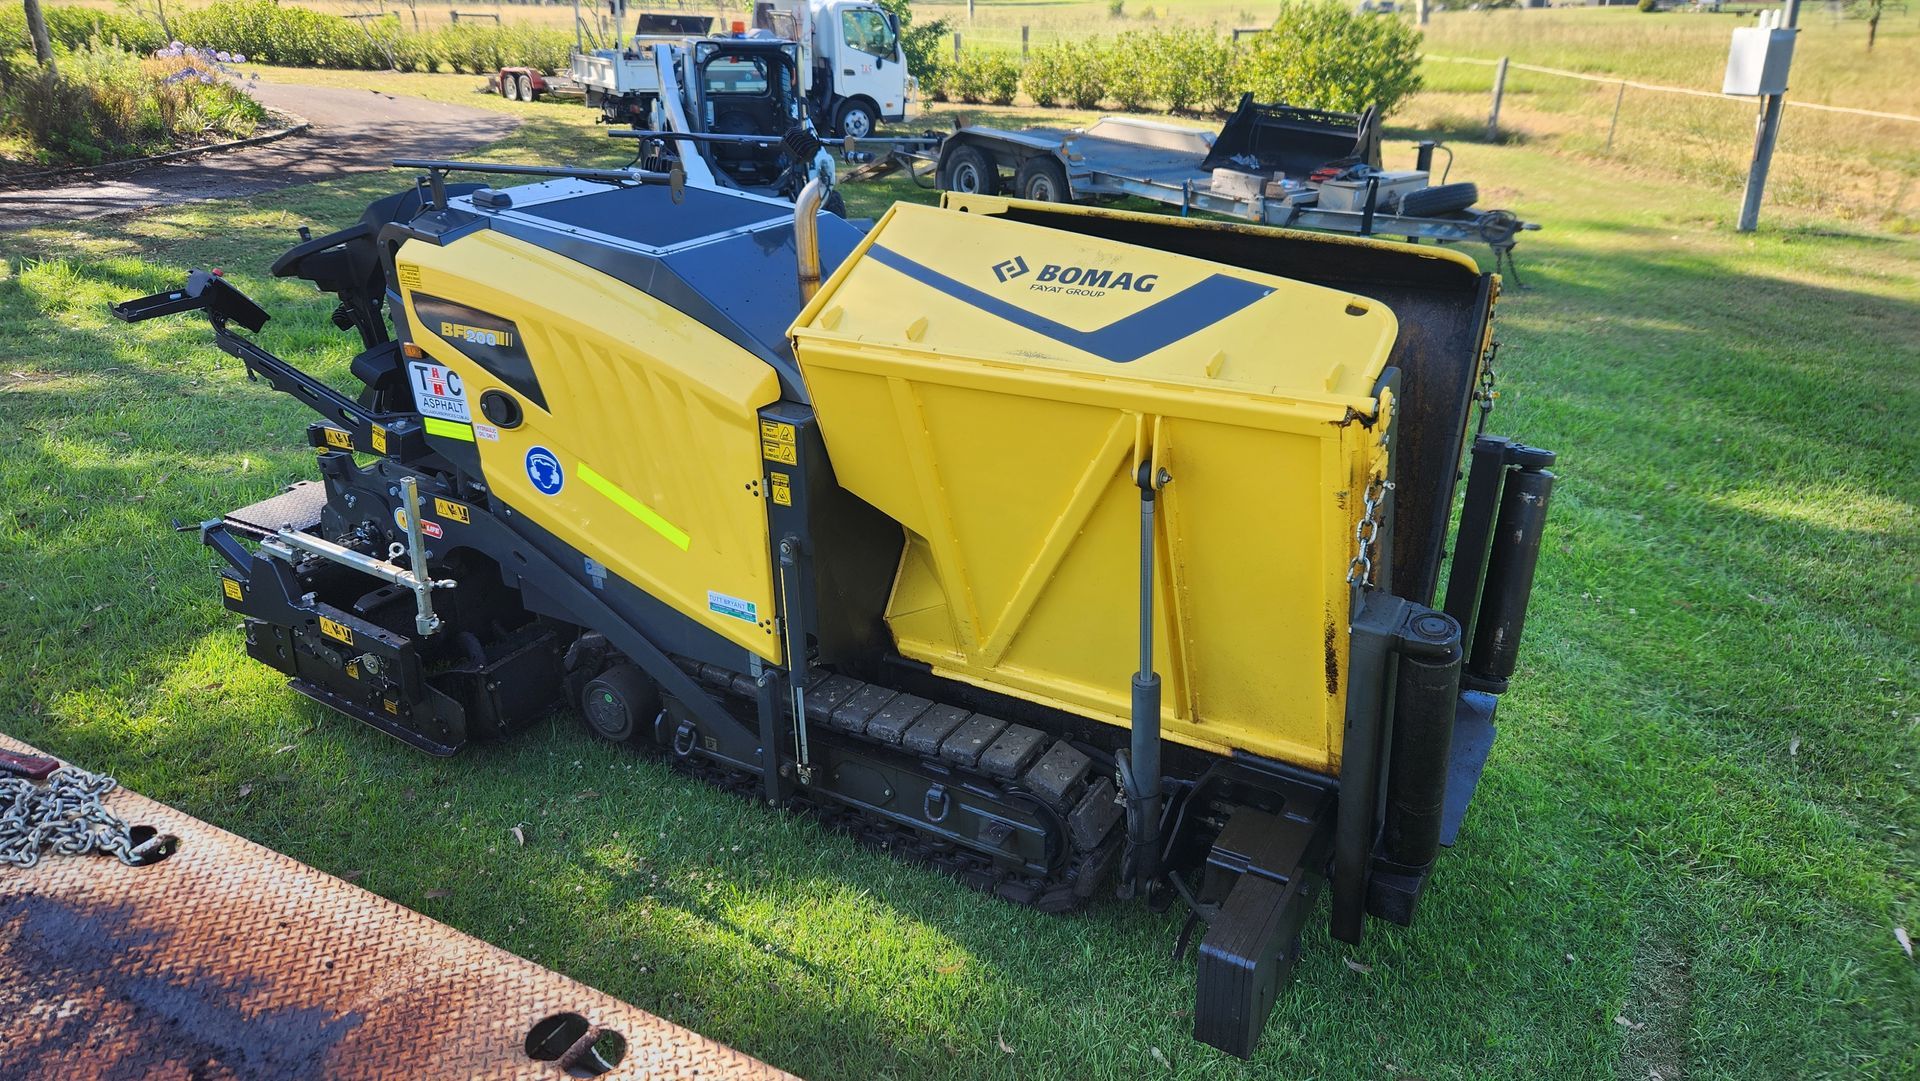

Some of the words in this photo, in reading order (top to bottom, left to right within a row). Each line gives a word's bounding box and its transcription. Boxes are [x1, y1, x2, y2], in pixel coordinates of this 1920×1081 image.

[1036, 264, 1158, 293] BOMAG
[1030, 284, 1064, 294] FAYAT
[1066, 288, 1105, 298] GROUP
[441, 322, 497, 346] BF200
[424, 397, 463, 413] ASPHALT
